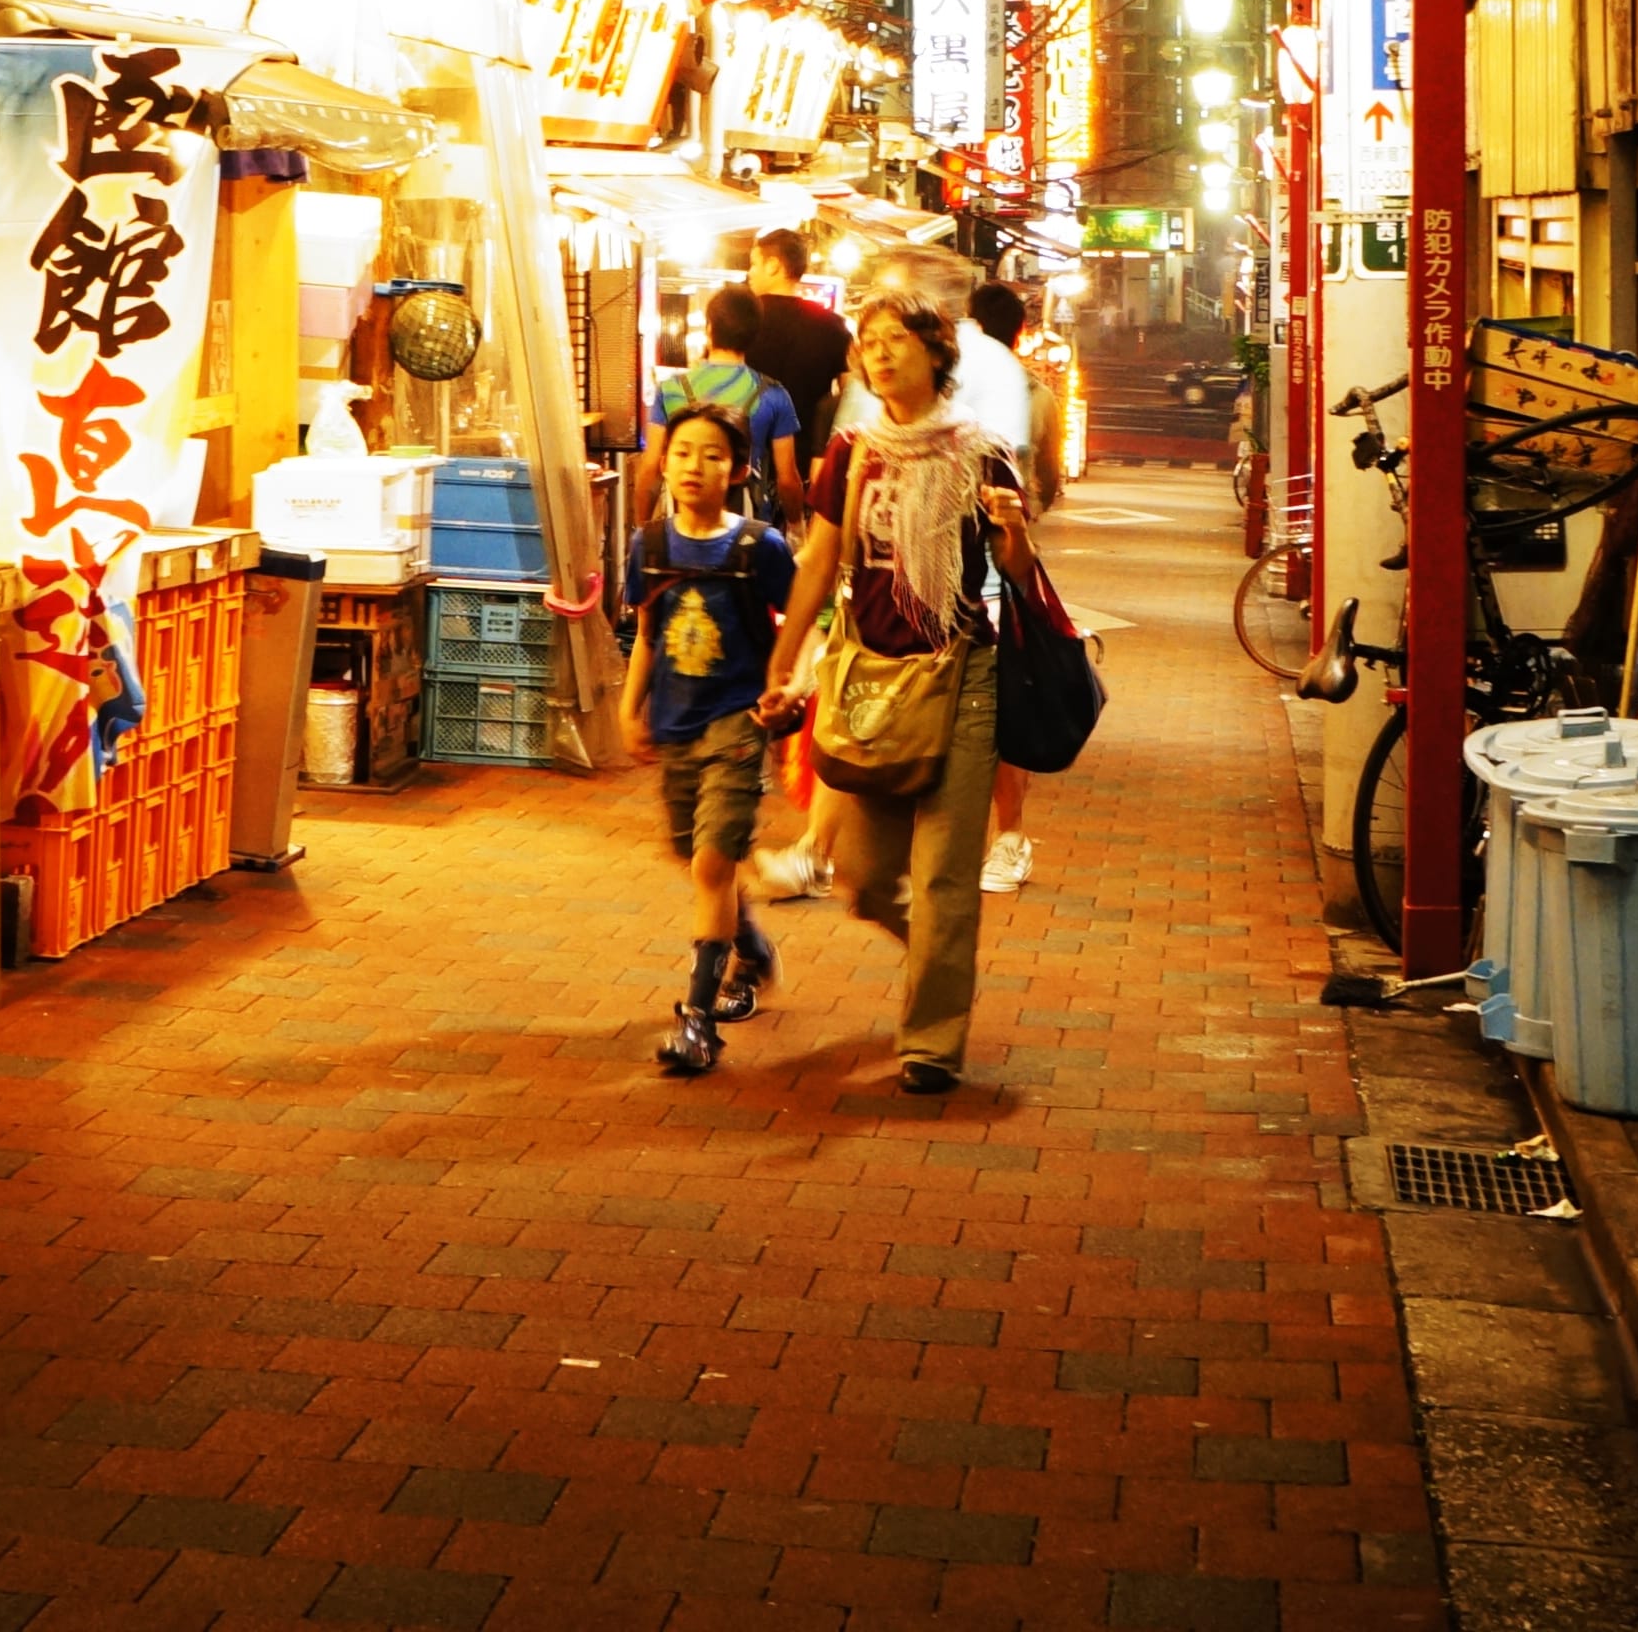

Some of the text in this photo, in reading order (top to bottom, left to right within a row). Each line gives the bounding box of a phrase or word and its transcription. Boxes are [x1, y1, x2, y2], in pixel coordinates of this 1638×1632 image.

[1423, 208, 1453, 391] 防犯カメラ作動中
